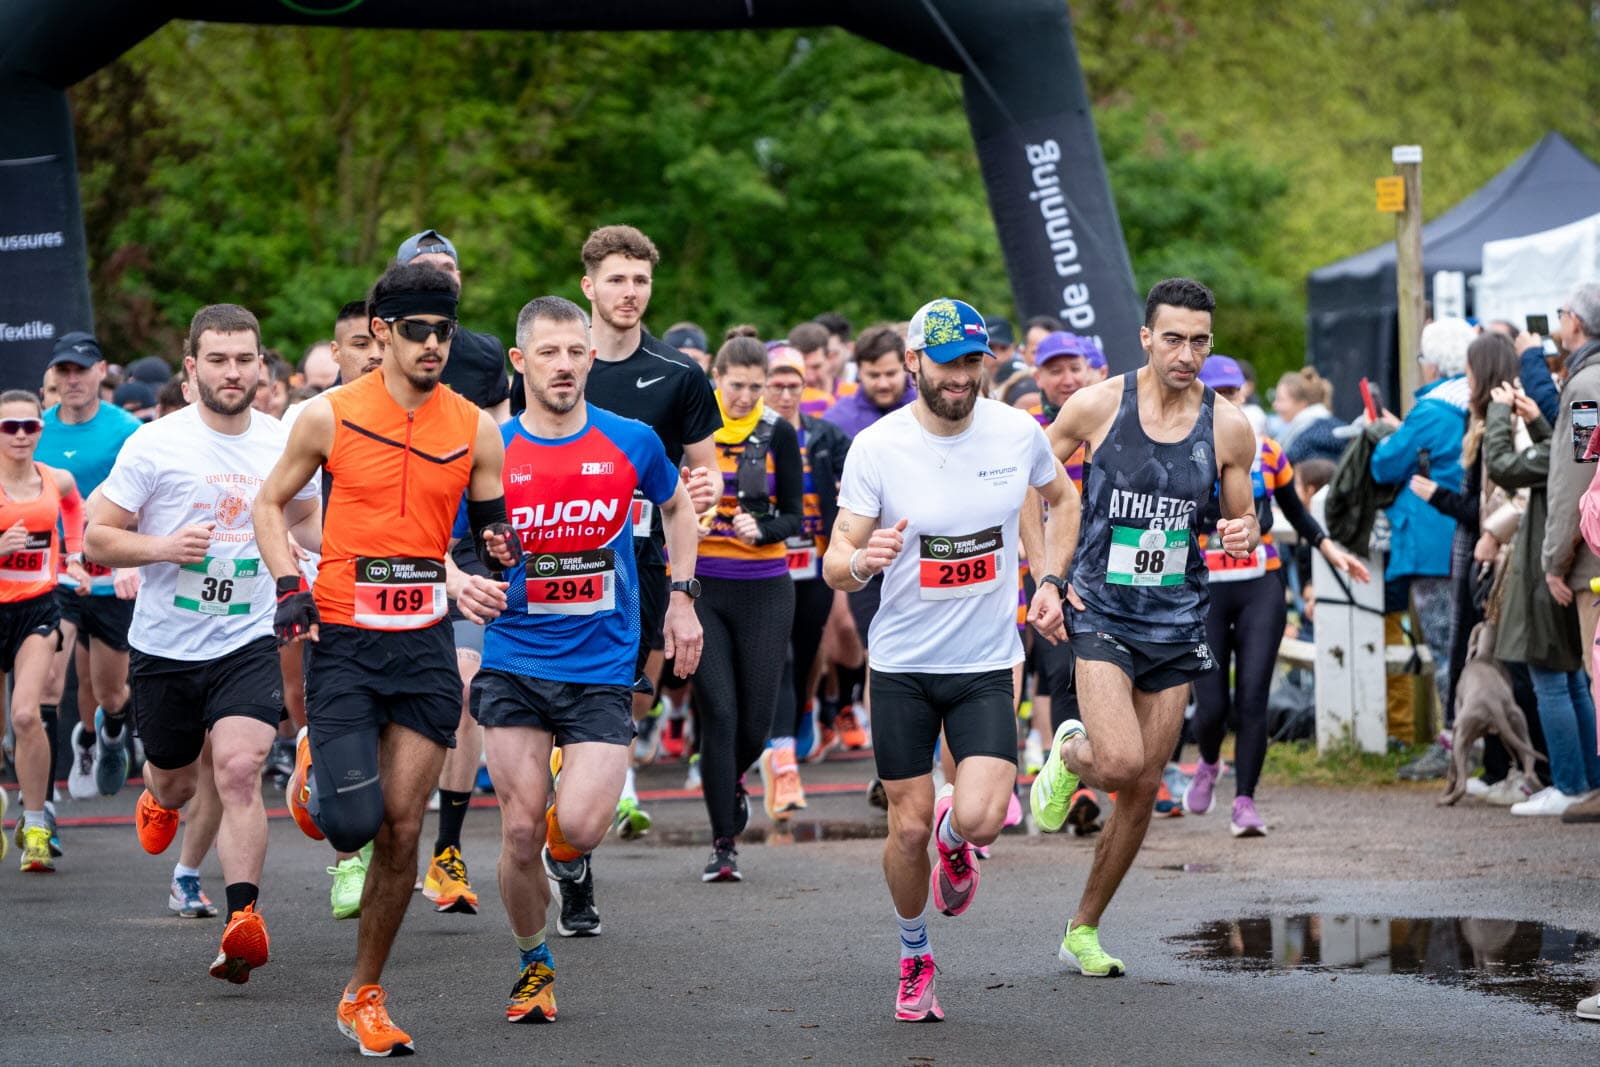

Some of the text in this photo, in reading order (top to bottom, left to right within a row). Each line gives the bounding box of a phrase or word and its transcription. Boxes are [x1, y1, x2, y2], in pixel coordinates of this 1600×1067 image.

[0, 231, 64, 251] ussures
[1025, 139, 1095, 329] de running
[0, 320, 55, 341] Textile
[510, 473, 531, 484] Dijon
[1108, 488, 1197, 518] ATHLETIC
[511, 498, 618, 530] DIJON
[1149, 513, 1190, 531] GYM
[522, 524, 605, 543] Triathlon
[933, 543, 949, 553] TDR
[954, 538, 976, 549] TERRE
[962, 539, 997, 554] RUNNING
[3, 552, 38, 569] 266
[392, 564, 415, 572] TERRE
[539, 561, 556, 571] TDR
[560, 556, 583, 566] TERRE
[570, 560, 606, 571] RUNNING
[1134, 549, 1165, 573] 98
[369, 566, 387, 577] TDR
[402, 570, 438, 579] RUNNING
[939, 560, 987, 584] 298
[201, 577, 234, 603] 36
[544, 578, 595, 601] 294
[376, 588, 424, 611] 169
